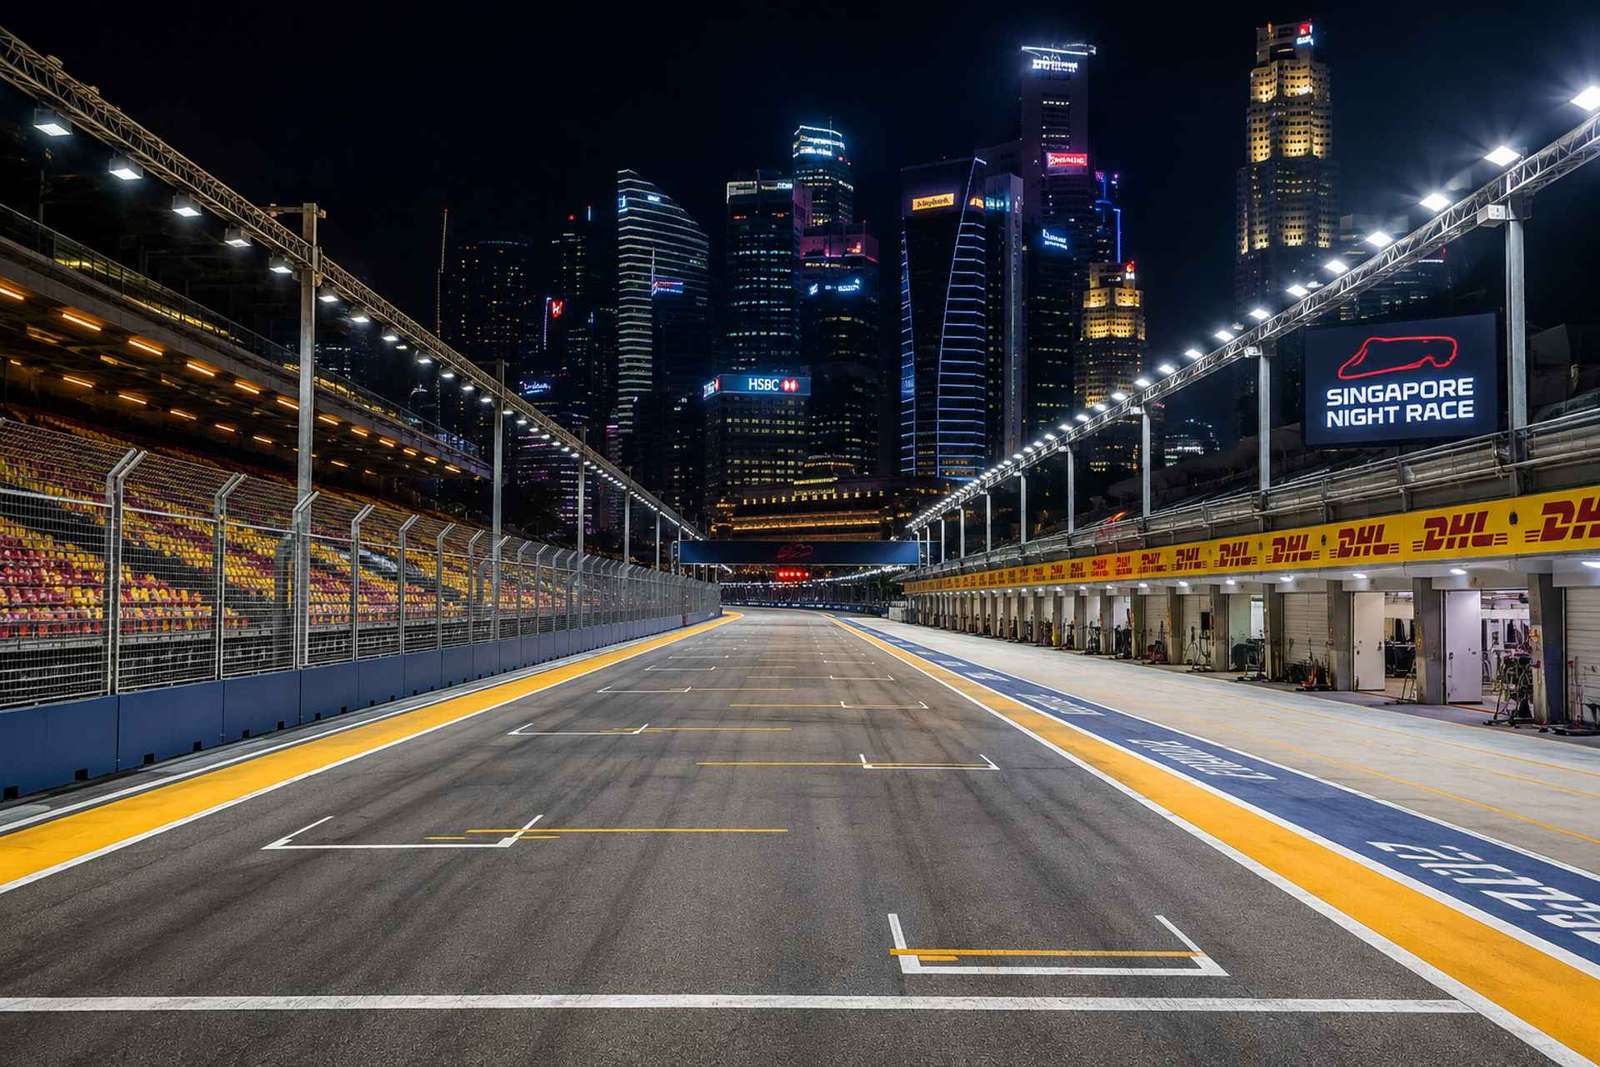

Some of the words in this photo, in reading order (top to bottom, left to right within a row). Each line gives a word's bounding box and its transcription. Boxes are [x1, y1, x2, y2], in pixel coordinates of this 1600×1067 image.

[748, 378, 779, 391] HSBC
[1326, 377, 1474, 406] SINGAPORE
[1326, 405, 1399, 428] NIGHT
[1406, 400, 1474, 423] RACE
[1219, 541, 1252, 567] DHL
[1272, 534, 1313, 563] DHL
[1337, 524, 1390, 558] DHL
[1423, 511, 1494, 551] DHL
[1540, 497, 1600, 542] DH
